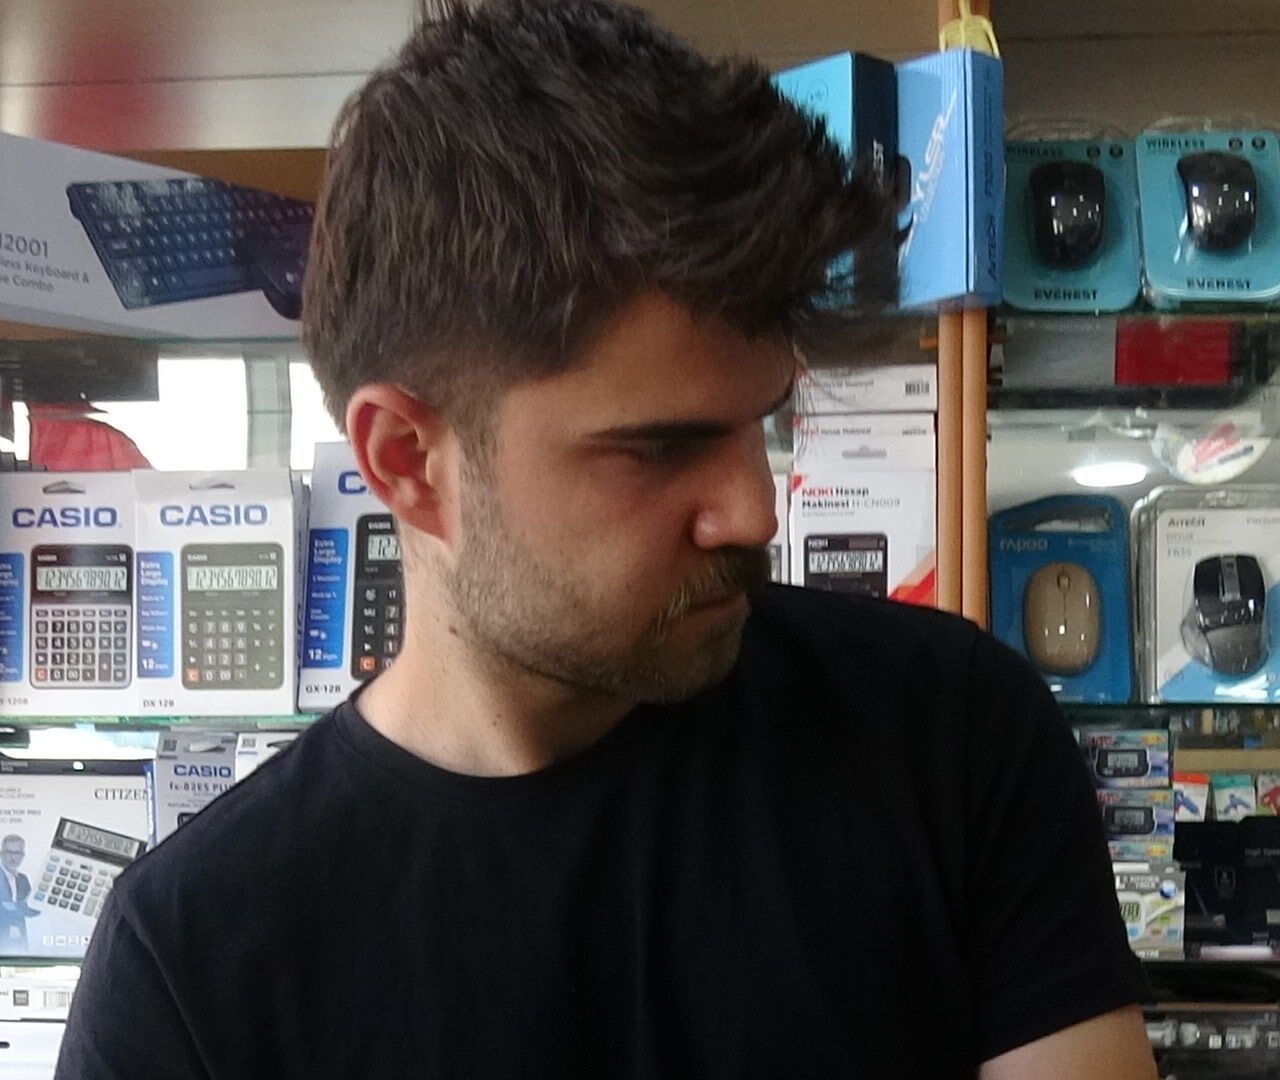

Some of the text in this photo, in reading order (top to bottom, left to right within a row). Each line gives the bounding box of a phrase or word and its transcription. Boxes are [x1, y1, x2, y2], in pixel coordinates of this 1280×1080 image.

[1145, 138, 1206, 149] WIRELESS
[25, 261, 79, 281] Keyboard
[12, 273, 54, 292] Combo
[1186, 277, 1252, 291] EVEREST
[1033, 288, 1098, 301] EVEREST
[802, 486, 869, 497] NOKI Hesap
[802, 499, 849, 509] Makinesi
[12, 507, 117, 528] CASIO
[160, 504, 268, 526] CASIO
[173, 764, 232, 778] CASIO
[94, 788, 150, 801] CITIZEN
